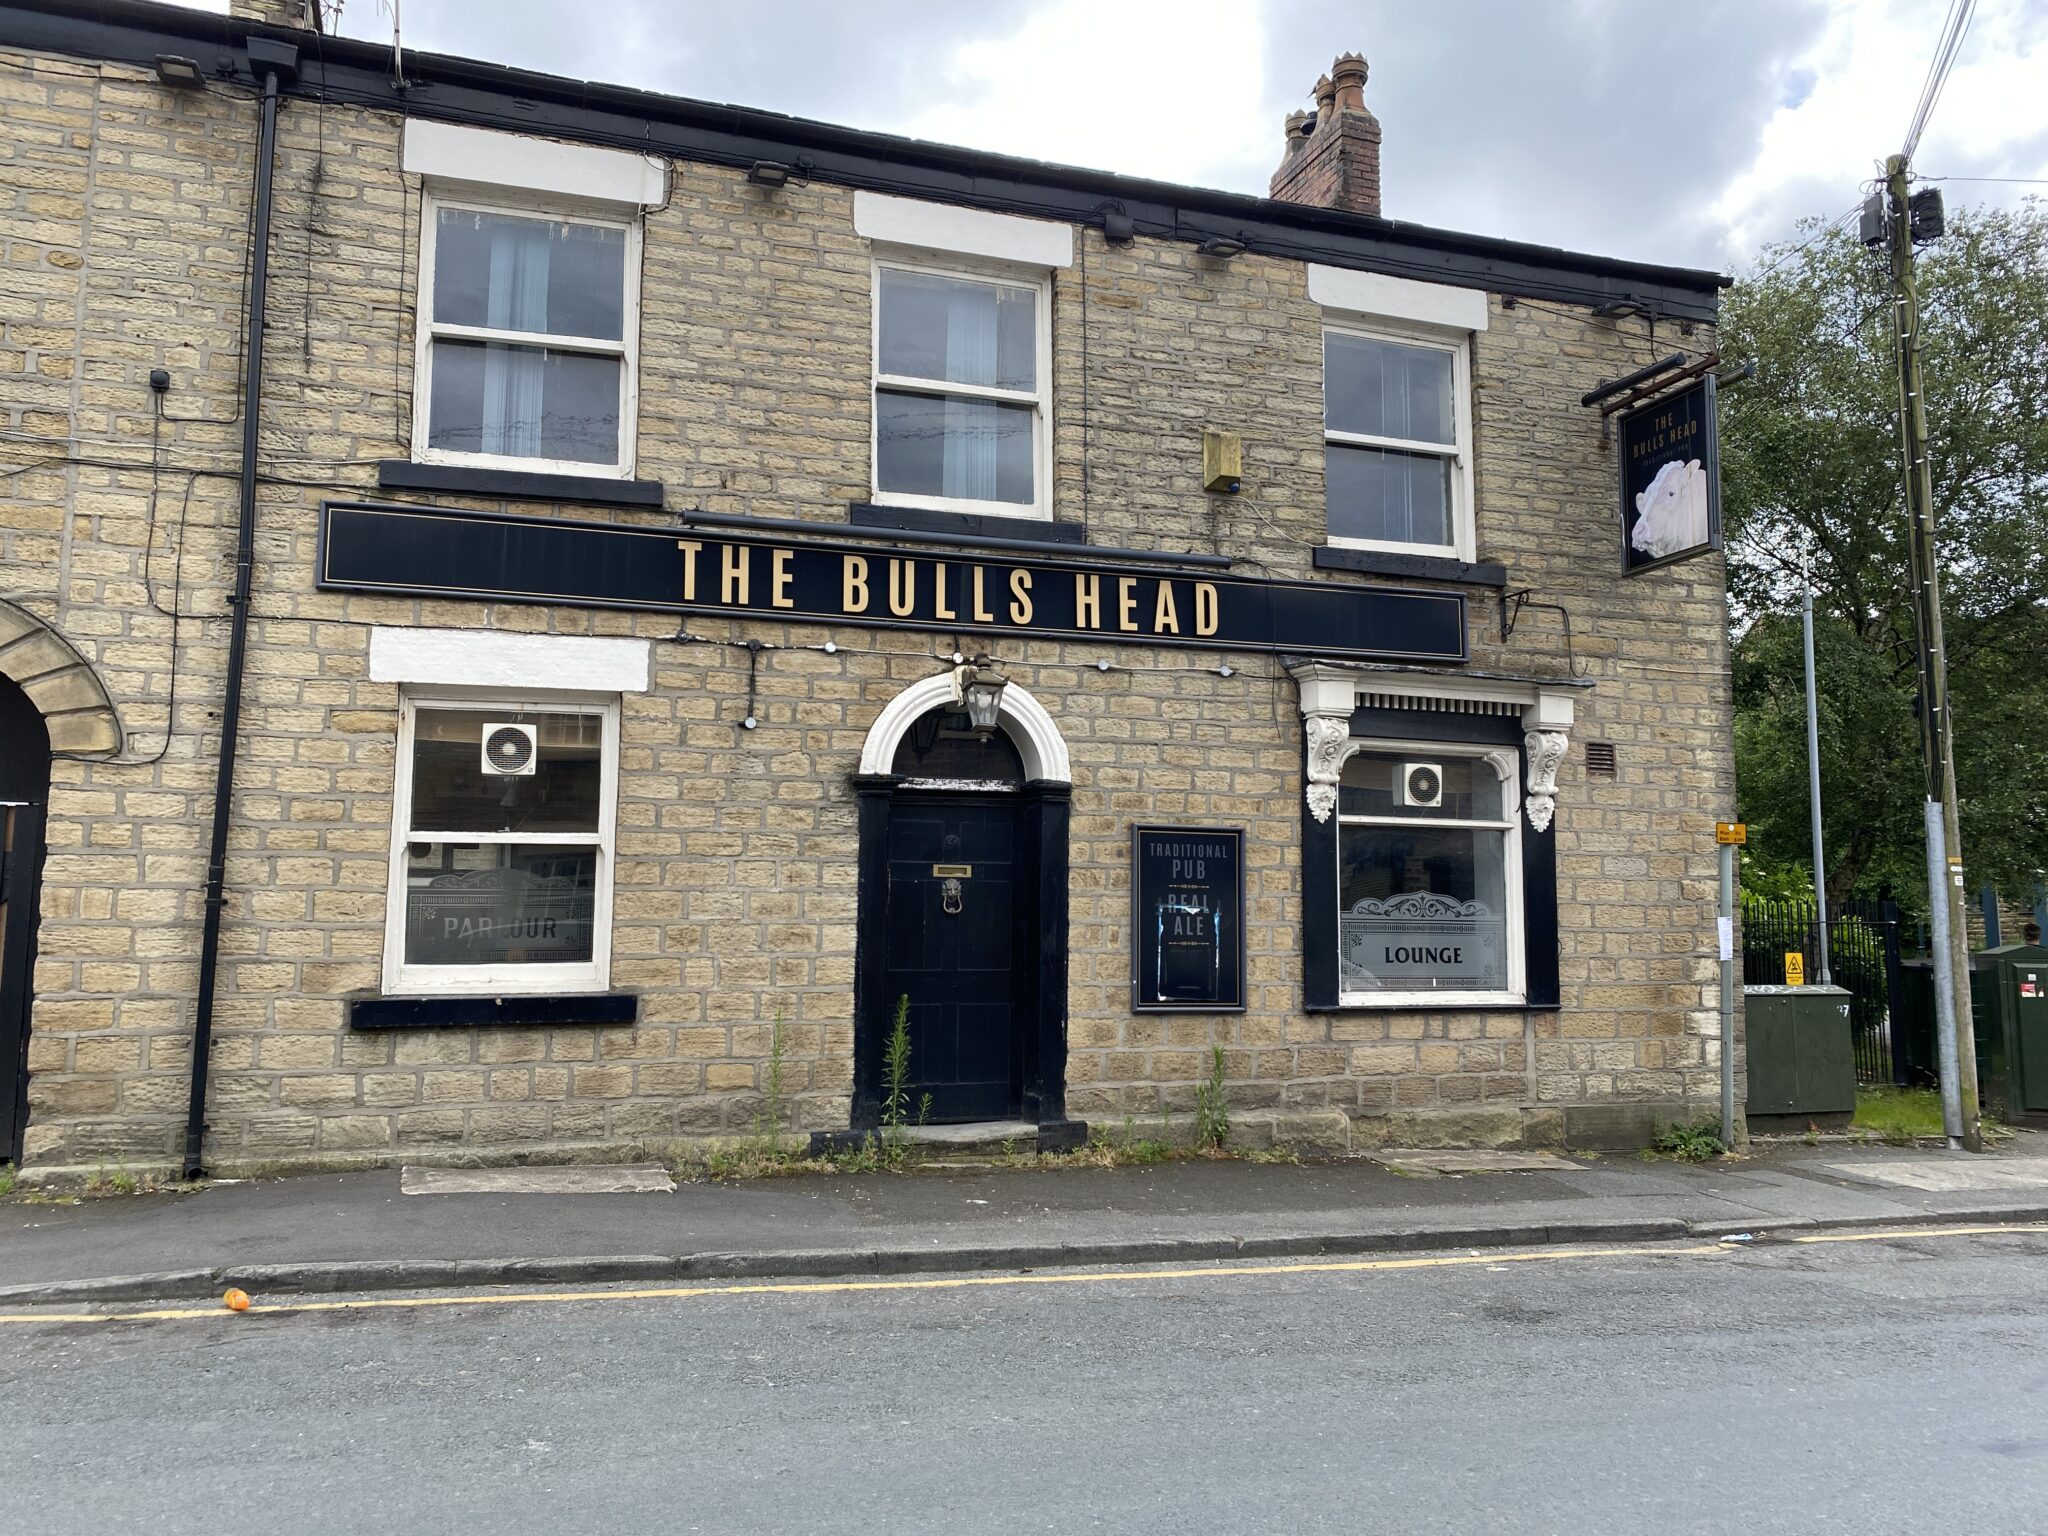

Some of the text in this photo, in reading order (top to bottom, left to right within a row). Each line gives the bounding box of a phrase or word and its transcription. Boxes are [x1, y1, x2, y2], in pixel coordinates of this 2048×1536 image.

[1654, 413, 1673, 431] THE
[1633, 434, 1664, 458] BULLS
[1670, 420, 1697, 443] HEAD
[677, 540, 1220, 636] THE BULLS HEAD
[1149, 842, 1228, 859] TRADITIONAL
[1172, 859, 1206, 879] PUB
[1168, 894, 1210, 914] REAL
[1174, 916, 1204, 936] ALE
[1385, 946, 1463, 964] LOUNGE
